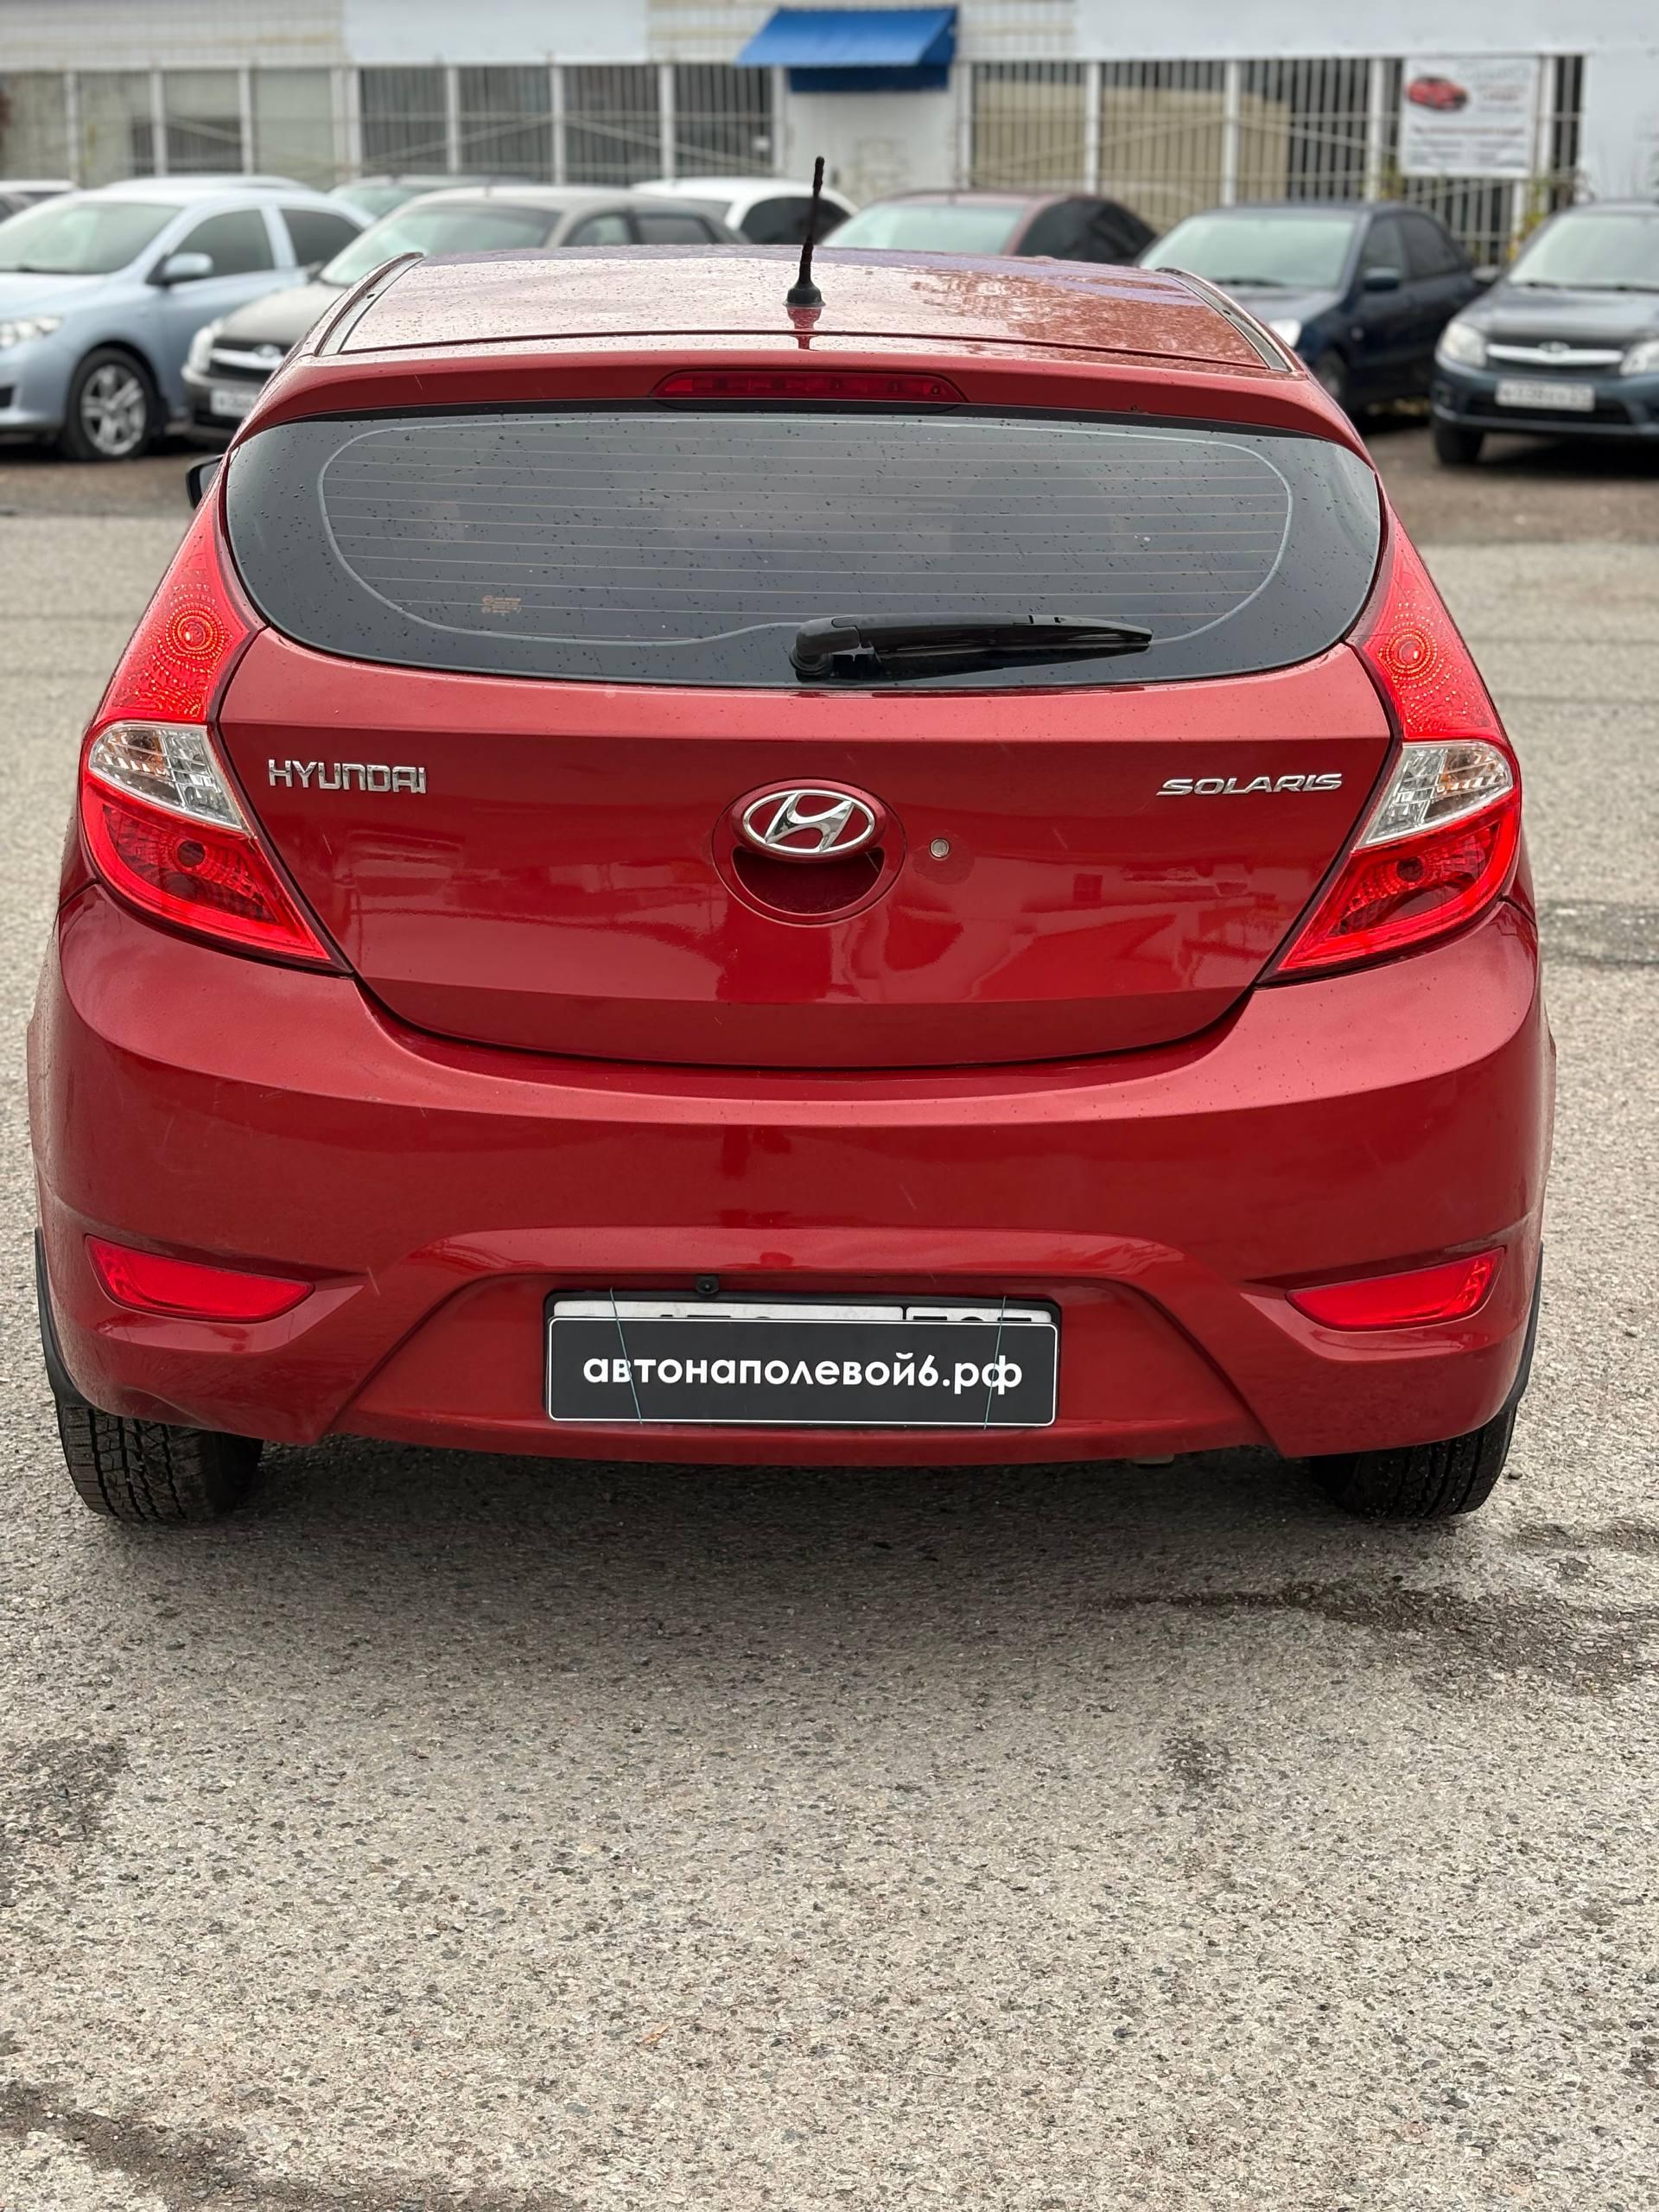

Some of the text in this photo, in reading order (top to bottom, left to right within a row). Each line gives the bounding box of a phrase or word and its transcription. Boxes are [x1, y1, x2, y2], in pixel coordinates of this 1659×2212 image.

[268, 759, 427, 794] HYUNDAI
[1155, 773, 1342, 797] SOLARIS
[582, 1351, 1023, 1395] автонаполевой6.рф
